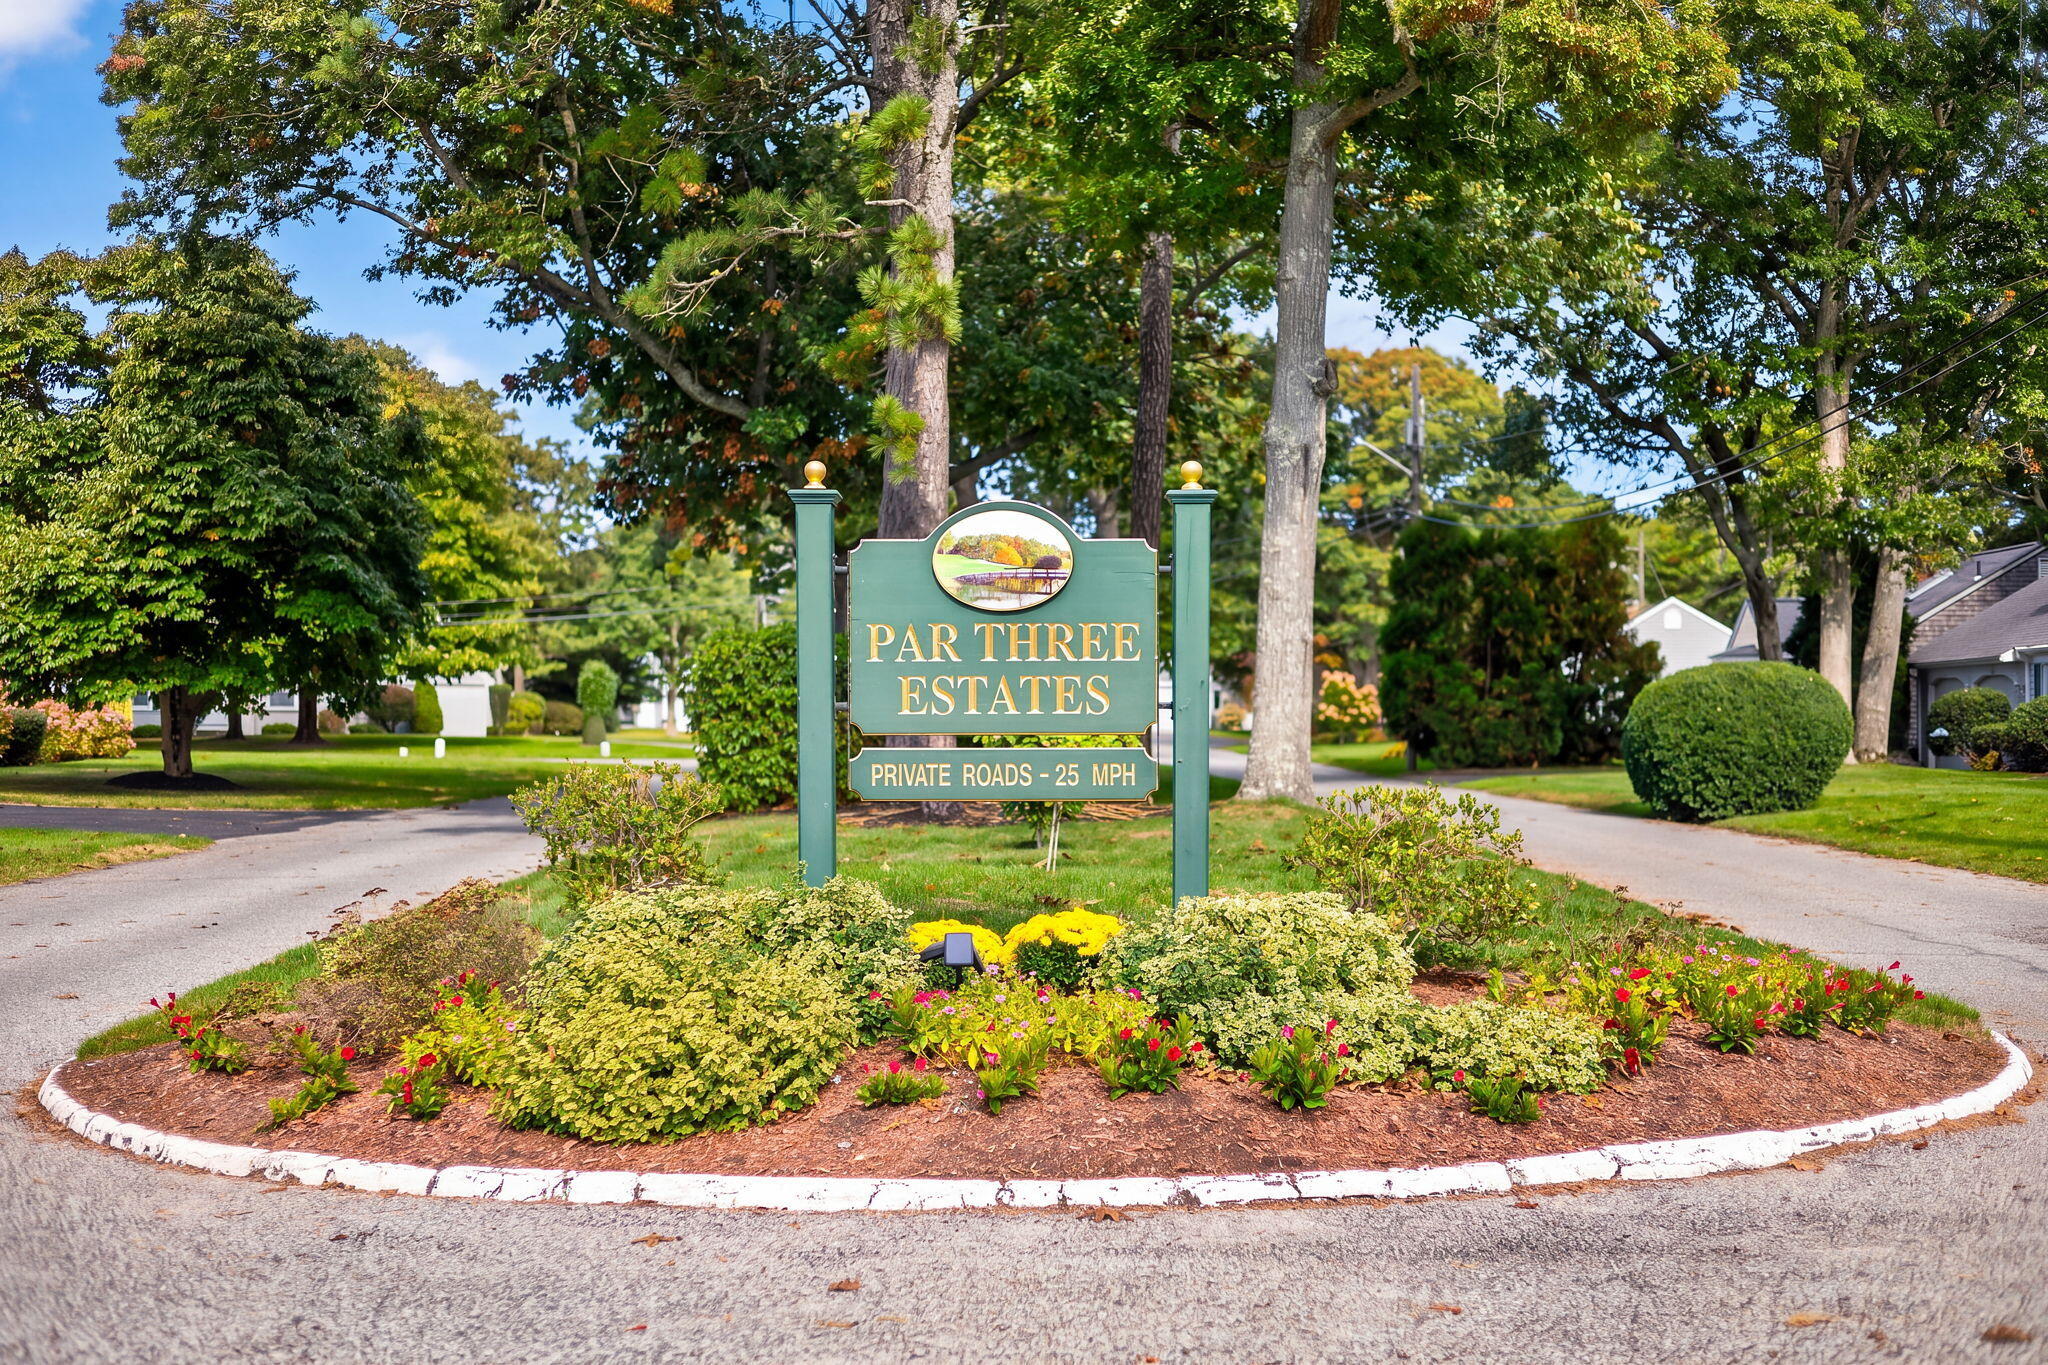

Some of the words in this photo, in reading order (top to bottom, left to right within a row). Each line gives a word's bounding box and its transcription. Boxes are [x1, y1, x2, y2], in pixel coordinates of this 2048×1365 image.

[866, 622, 963, 663] PAR
[974, 622, 1142, 663] THREE
[896, 674, 1111, 716] ESTATES
[870, 763, 952, 787] PRIVATE
[962, 762, 1033, 788] ROADS
[1055, 763, 1080, 787] 25
[1092, 762, 1137, 787] MPH
